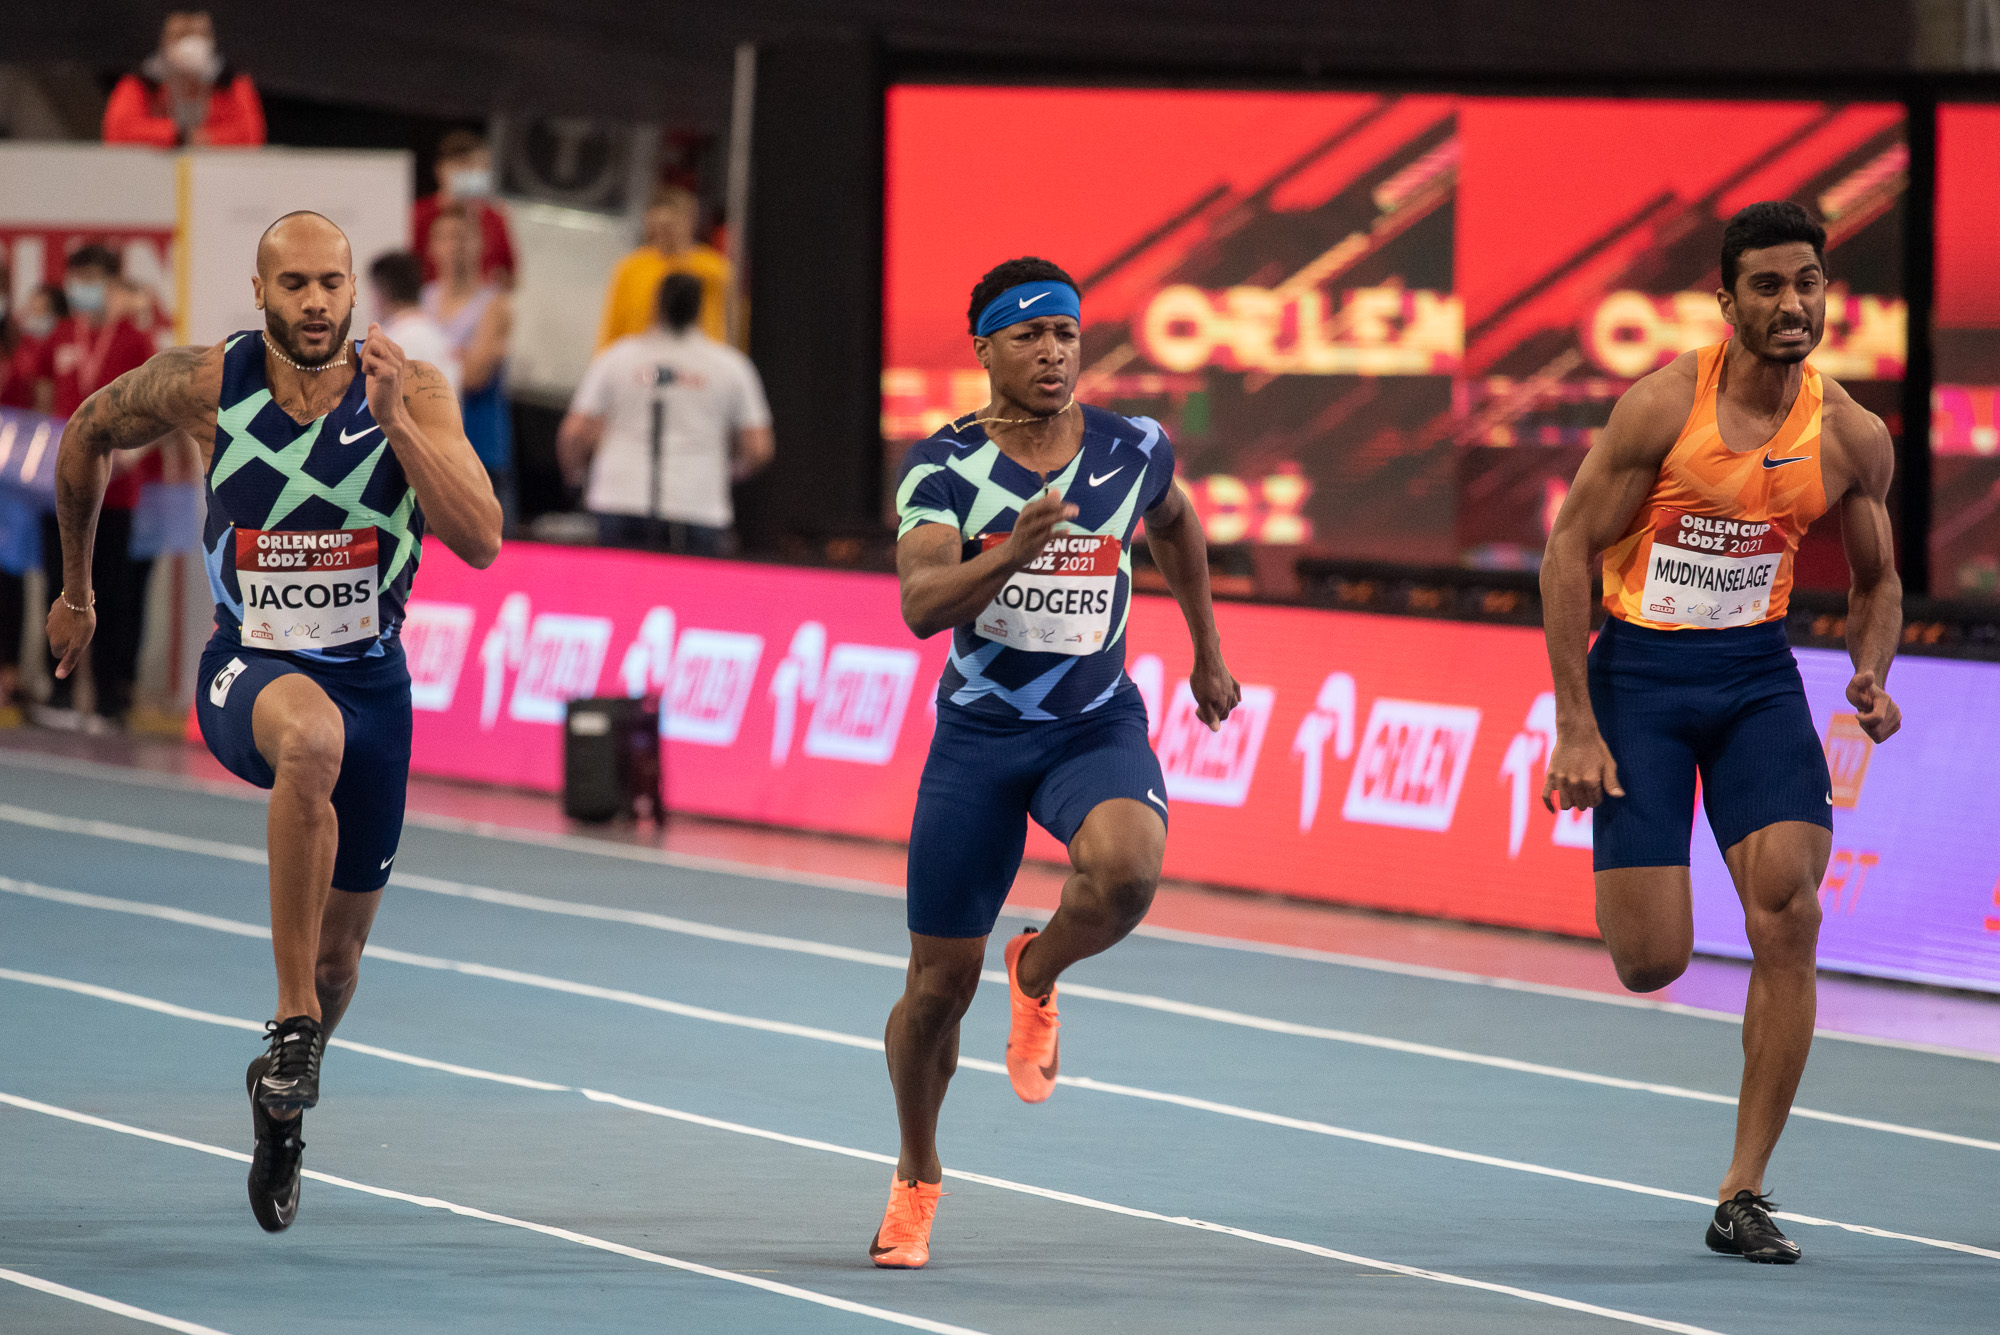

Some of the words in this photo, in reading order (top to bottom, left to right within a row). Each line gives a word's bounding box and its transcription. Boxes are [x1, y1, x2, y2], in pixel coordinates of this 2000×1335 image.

[1680, 514, 1738, 536] ORLEN
[1740, 523, 1771, 538] CUP
[256, 534, 317, 549] ORLEN
[318, 533, 353, 549] CUP
[1068, 538, 1101, 553] CUP
[1677, 530, 1726, 551] ŁÓDŹ
[1729, 539, 1763, 554] 2021
[257, 550, 307, 568] ŁÓDŹ
[312, 551, 350, 567] 2021
[1022, 553, 1056, 571] DŹ
[1059, 556, 1095, 571] 2021
[1654, 556, 1772, 593] MUDIYANSELAGE
[248, 579, 371, 610] JACOBS
[994, 584, 1109, 615] ODGERS
